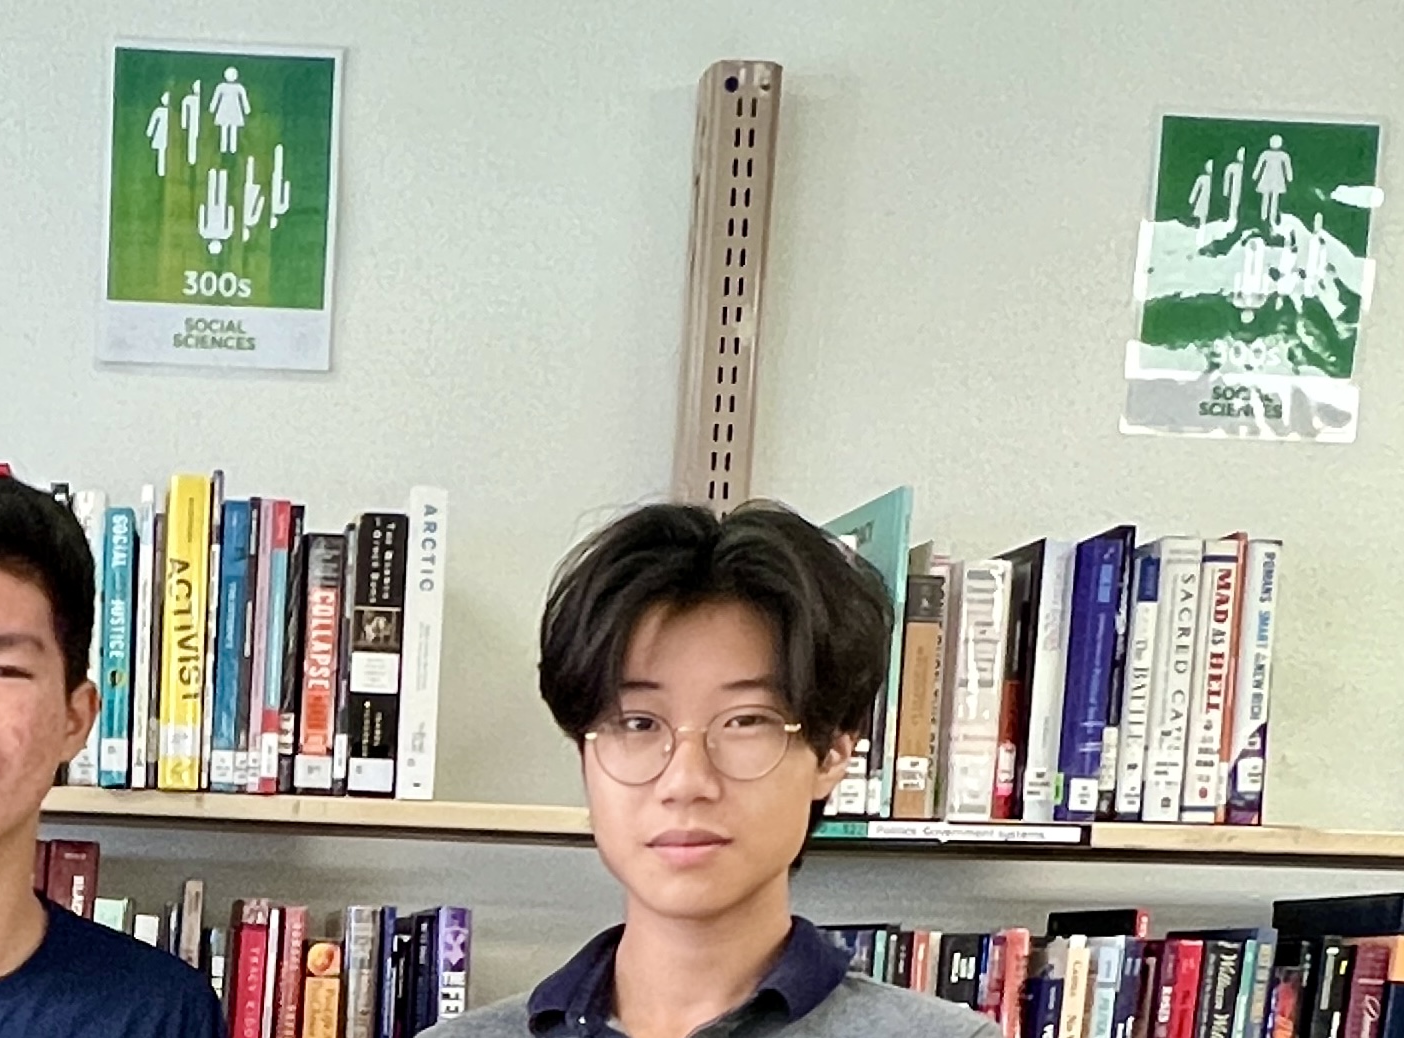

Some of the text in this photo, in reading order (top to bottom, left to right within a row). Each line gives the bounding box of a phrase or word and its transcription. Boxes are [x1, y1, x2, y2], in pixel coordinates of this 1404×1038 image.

[182, 270, 252, 298] 300s
[172, 334, 257, 351] SCIENCES
[184, 317, 247, 334] SOCIAL
[1199, 401, 1283, 419] SCIENES
[418, 503, 439, 592] ARCTIC
[108, 513, 129, 659] SOCIAL JUSTICE
[167, 558, 202, 701] ACTIVIST
[307, 586, 336, 690] COLLAPSE
[1174, 573, 1196, 674] SACRED
[1206, 567, 1233, 715] MAD AS HELL
[1256, 609, 1272, 649] SMART
[1213, 953, 1237, 1010] William
